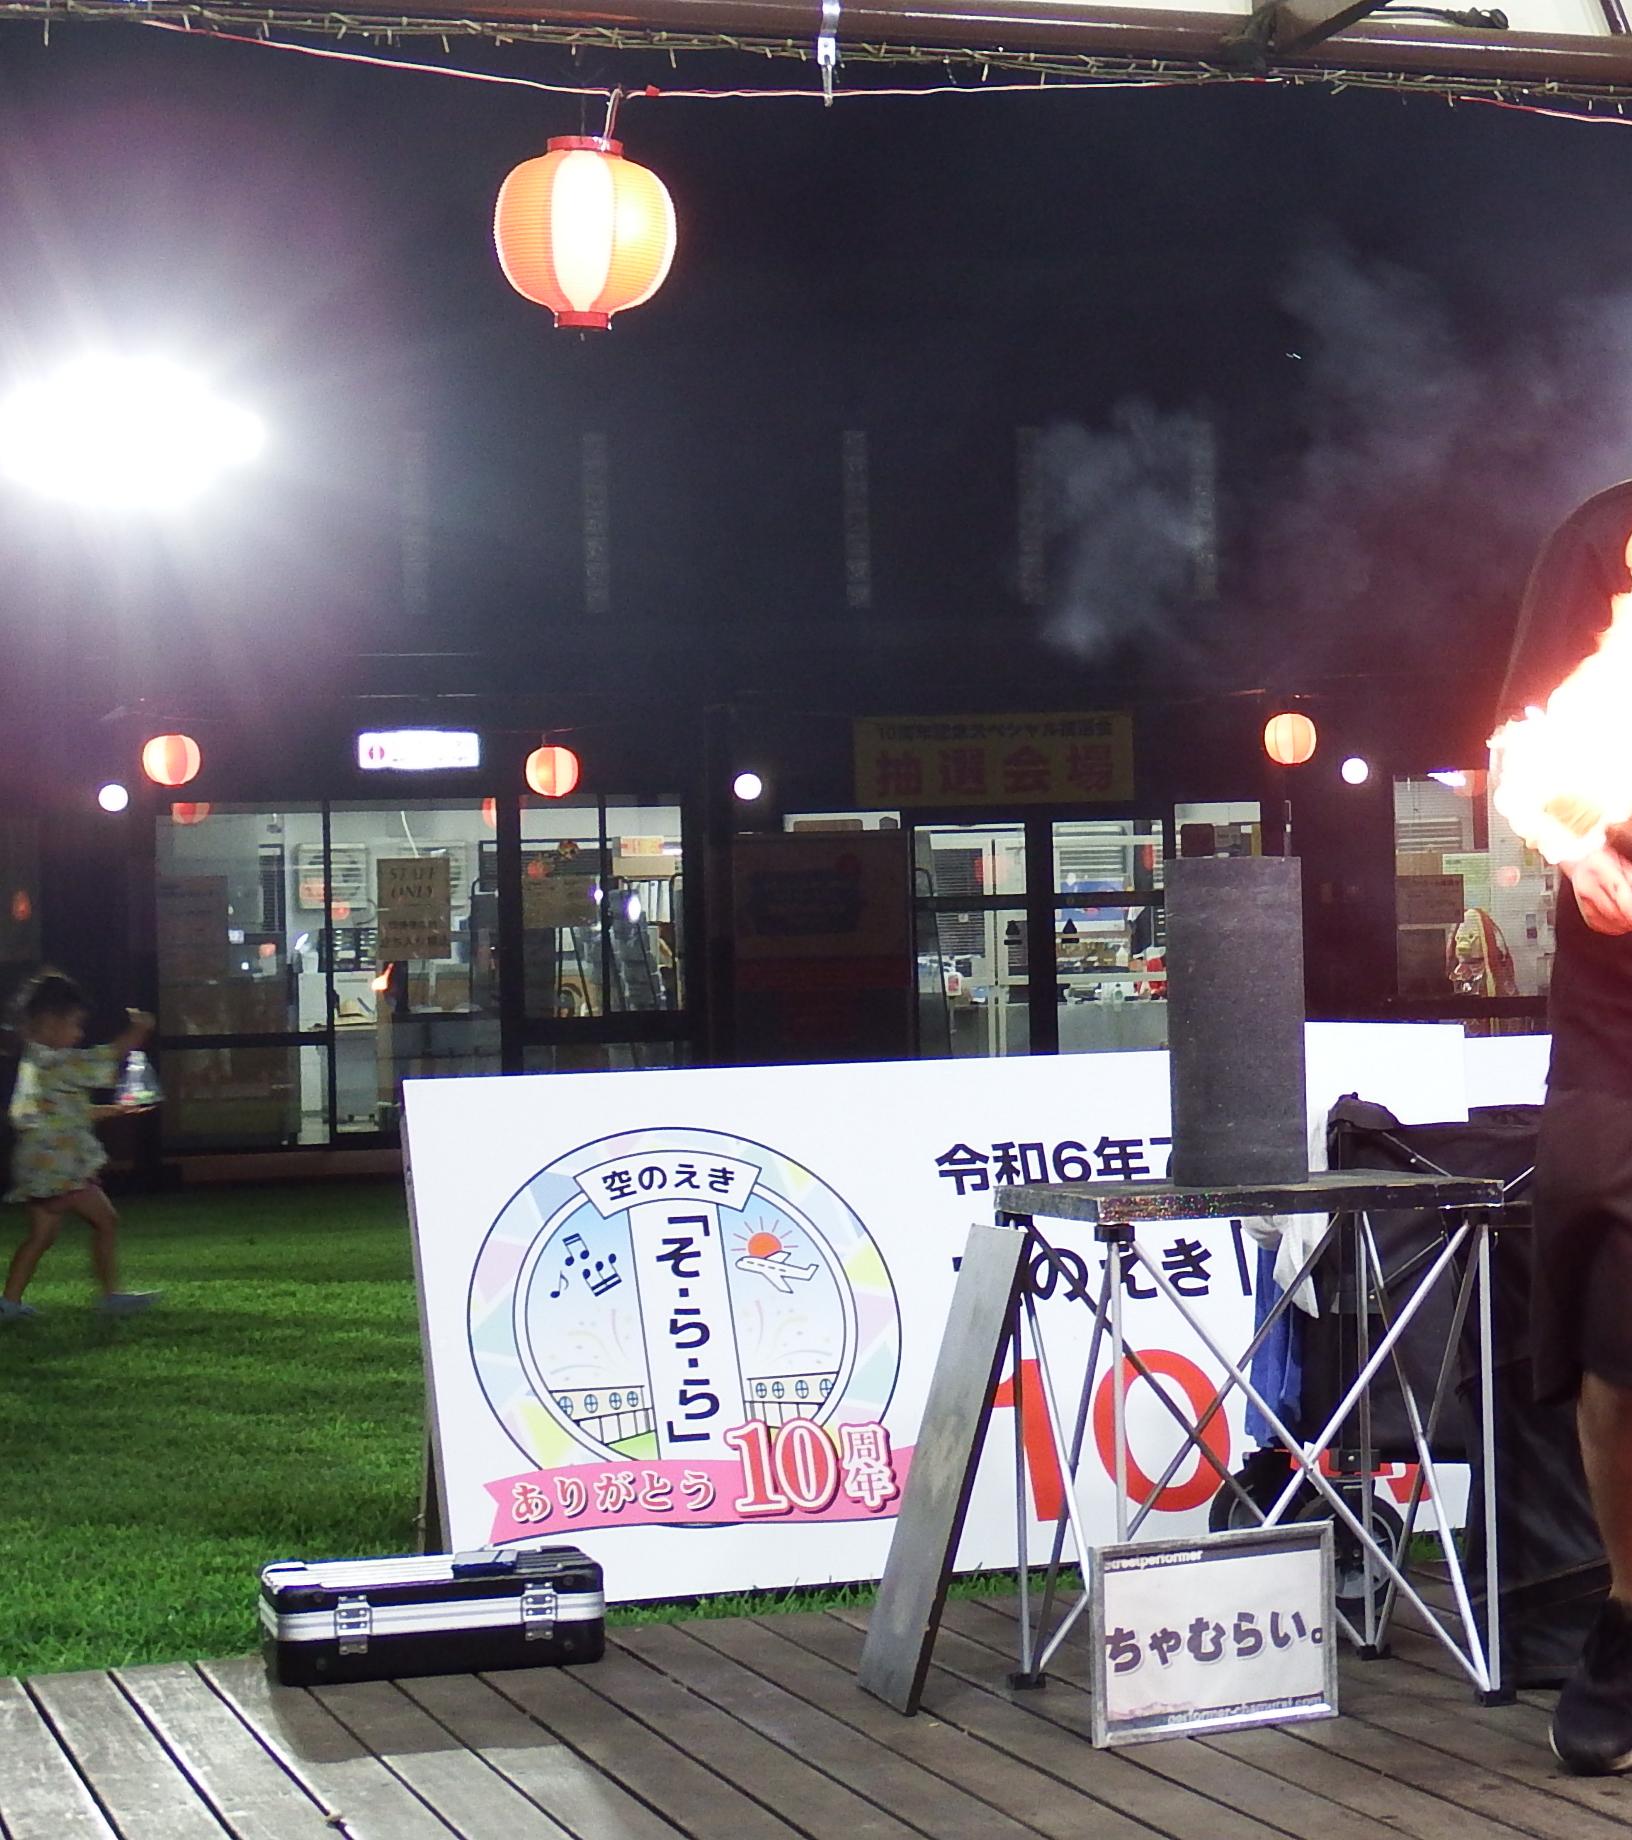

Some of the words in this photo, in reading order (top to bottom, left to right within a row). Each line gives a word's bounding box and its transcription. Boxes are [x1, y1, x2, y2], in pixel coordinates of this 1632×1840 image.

[876, 744, 1114, 797] 抽選会場
[602, 1163, 735, 1200] 空のえき
[511, 1470, 717, 1523] ありがとう
